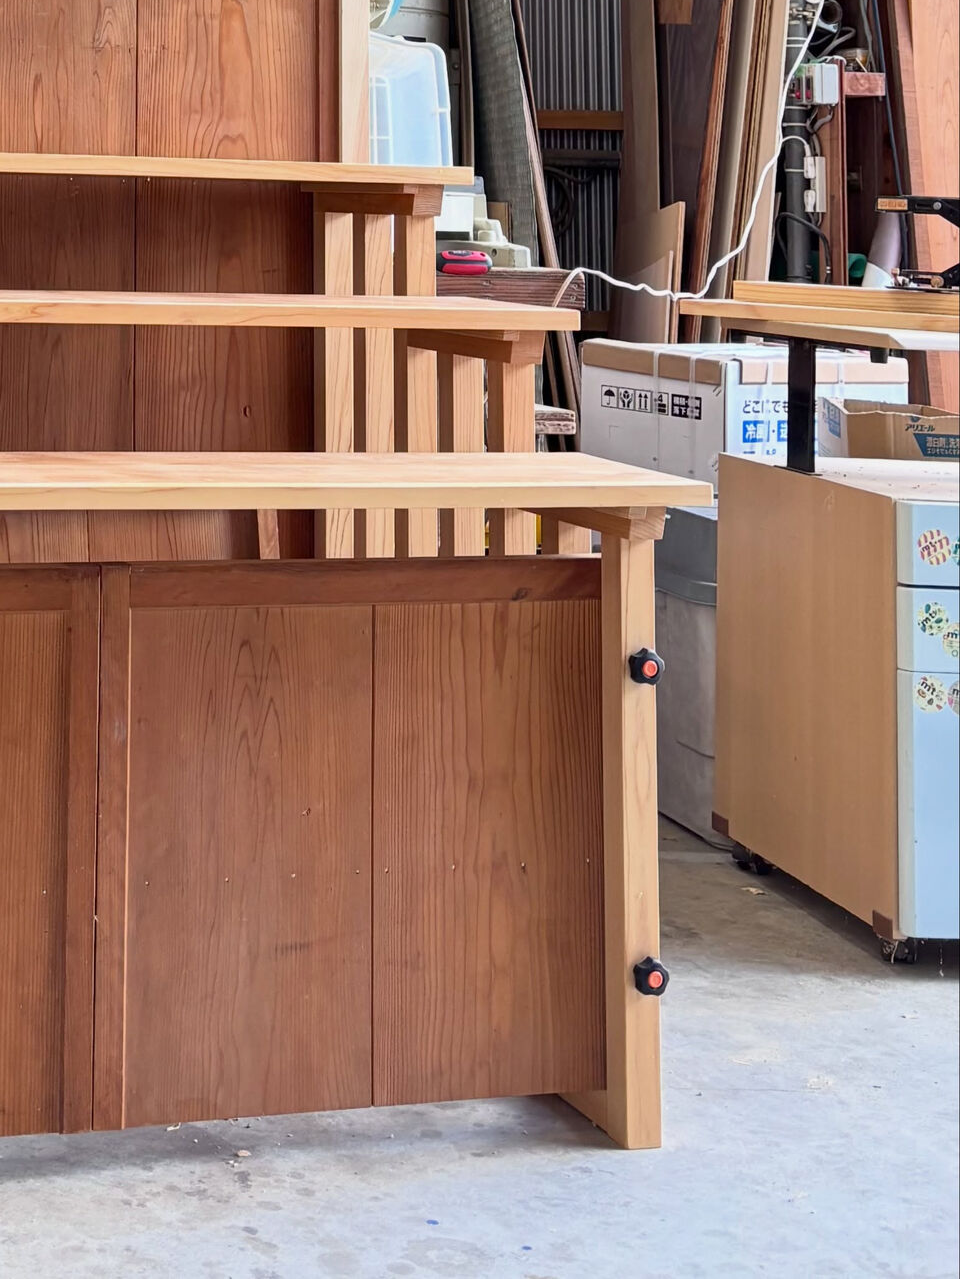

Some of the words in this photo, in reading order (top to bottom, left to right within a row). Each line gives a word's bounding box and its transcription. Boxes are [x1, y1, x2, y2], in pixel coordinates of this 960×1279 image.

[904, 424, 936, 432] アリエール
